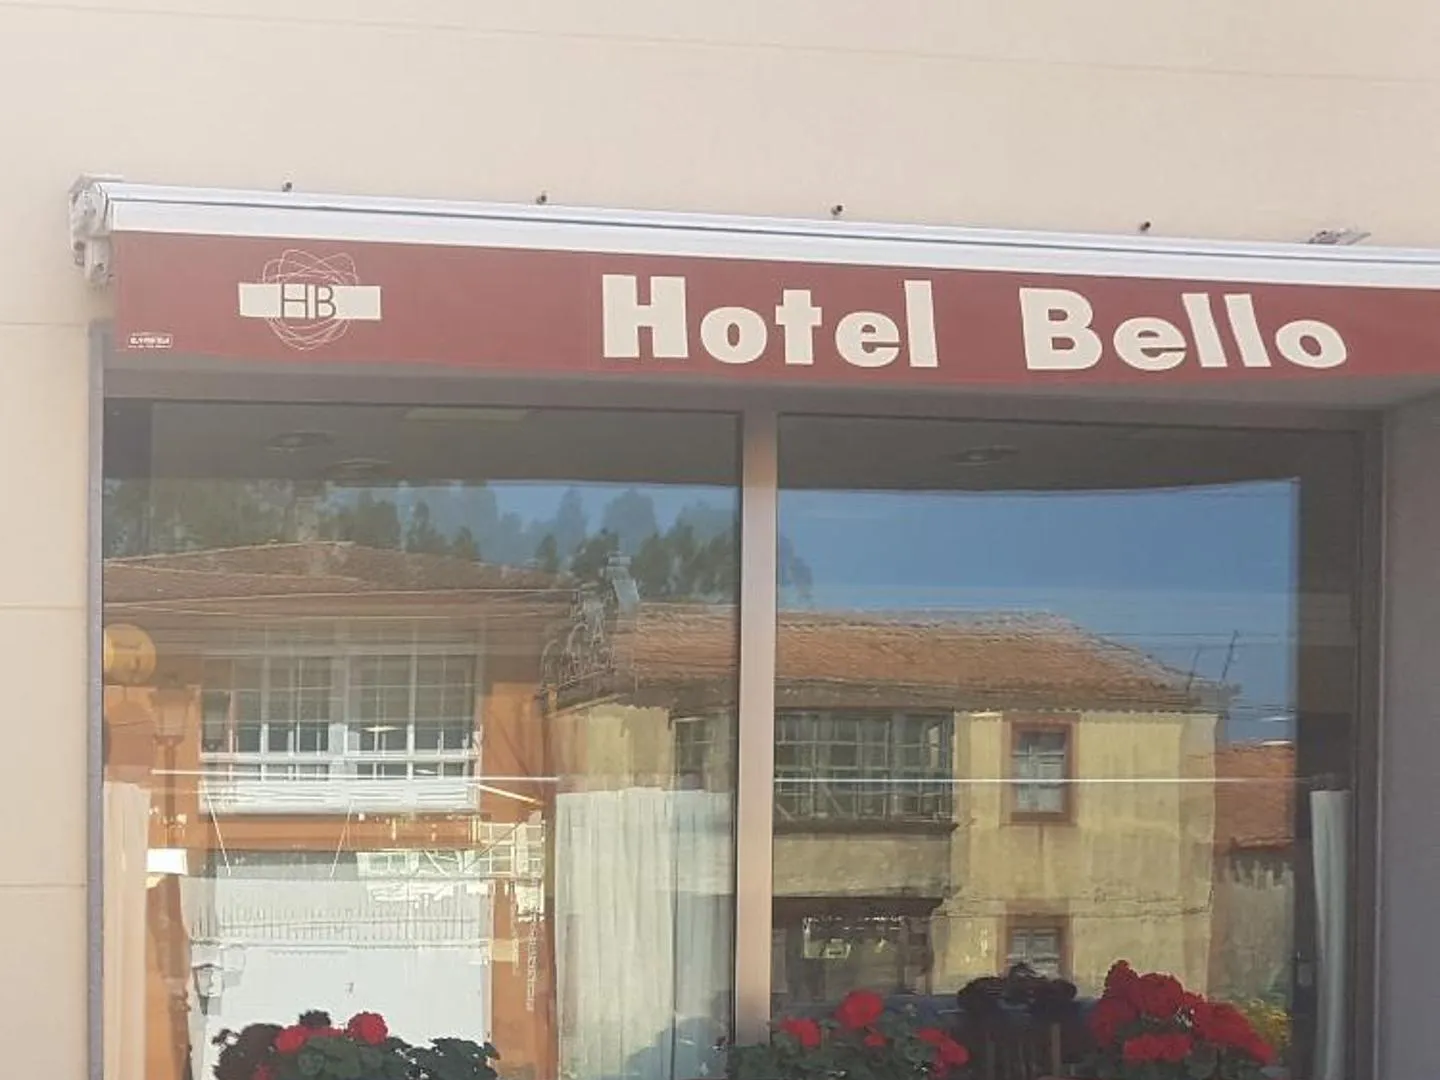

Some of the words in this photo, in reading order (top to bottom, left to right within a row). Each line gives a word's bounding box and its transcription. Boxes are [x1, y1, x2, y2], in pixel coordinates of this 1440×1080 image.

[281, 283, 337, 320] HB
[602, 274, 939, 368] Hotel
[1019, 287, 1348, 371] Bello
